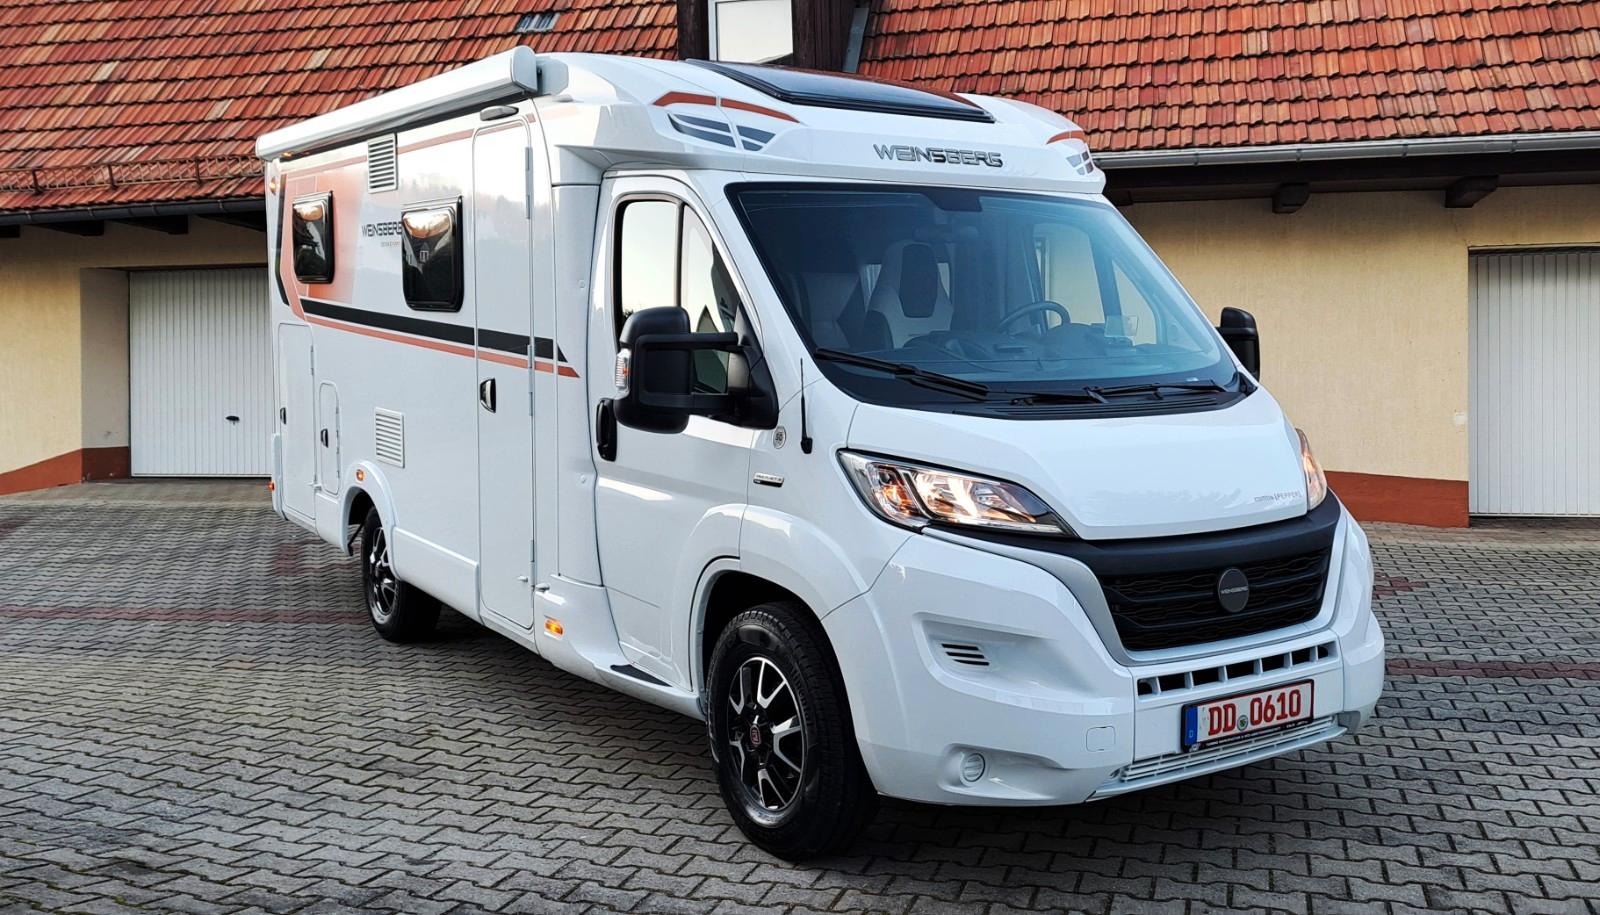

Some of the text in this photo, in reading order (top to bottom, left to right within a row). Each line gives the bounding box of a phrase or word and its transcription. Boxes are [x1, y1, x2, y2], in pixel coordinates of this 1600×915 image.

[873, 143, 1003, 168] WEINSBERG
[1208, 689, 1302, 736] DD 0610
